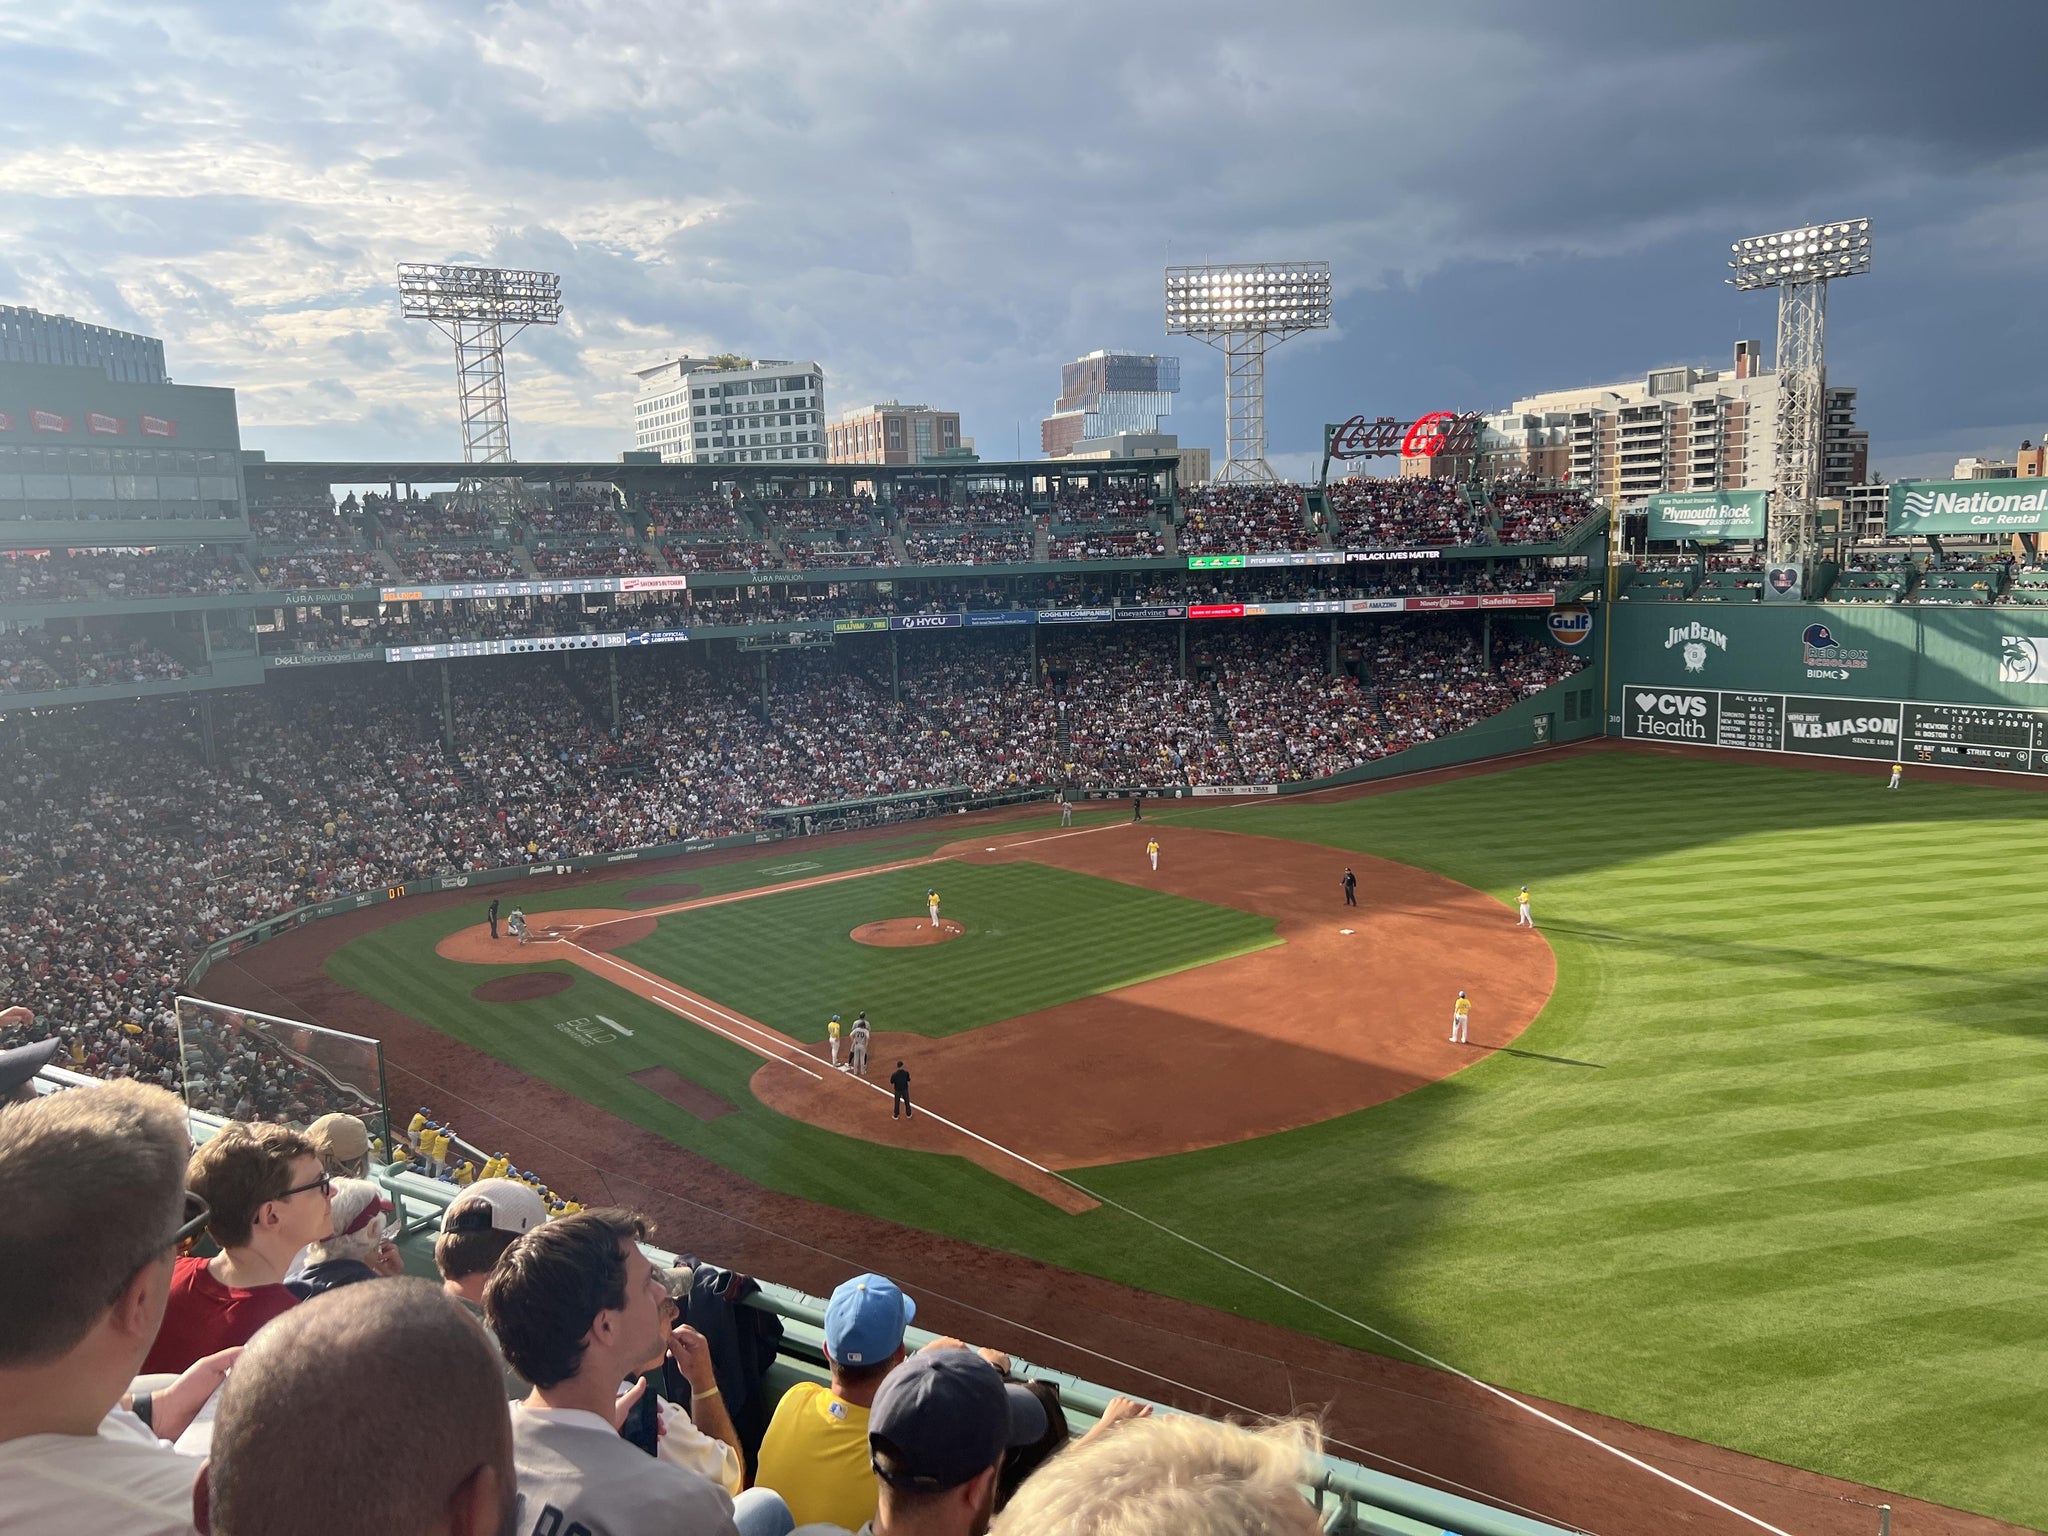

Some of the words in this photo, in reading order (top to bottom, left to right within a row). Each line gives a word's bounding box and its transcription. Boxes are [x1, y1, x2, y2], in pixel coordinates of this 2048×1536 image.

[1662, 506, 1717, 520] Plymouth
[1719, 504, 1750, 518] Rock
[1971, 515, 1993, 524] Car
[1996, 514, 2040, 524] Rental
[1358, 553, 1385, 561] BLACK
[1386, 552, 1408, 560] LIVES
[1408, 551, 1440, 559] MATTER
[836, 622, 864, 630] SULLIVAN
[917, 618, 946, 626] HYCU
[1549, 614, 1589, 630] Gulf
[1664, 627, 1689, 649] JIM
[1690, 621, 1728, 651] BEAM
[274, 657, 300, 665] DELL
[300, 655, 352, 664] Technologies
[353, 651, 374, 659] Level
[1809, 649, 1836, 658] RED
[1840, 650, 1868, 659] SOX
[1808, 659, 1868, 668] SCHOLARS
[1807, 669, 1838, 679] BIDMC
[1658, 694, 1707, 717] CVS
[1934, 708, 1987, 716] FENWAY
[1637, 714, 1706, 738] Health
[1792, 718, 1899, 738] W.B.MASON
[1918, 752, 1932, 760] 35
[1966, 748, 1990, 756] STRIKE
